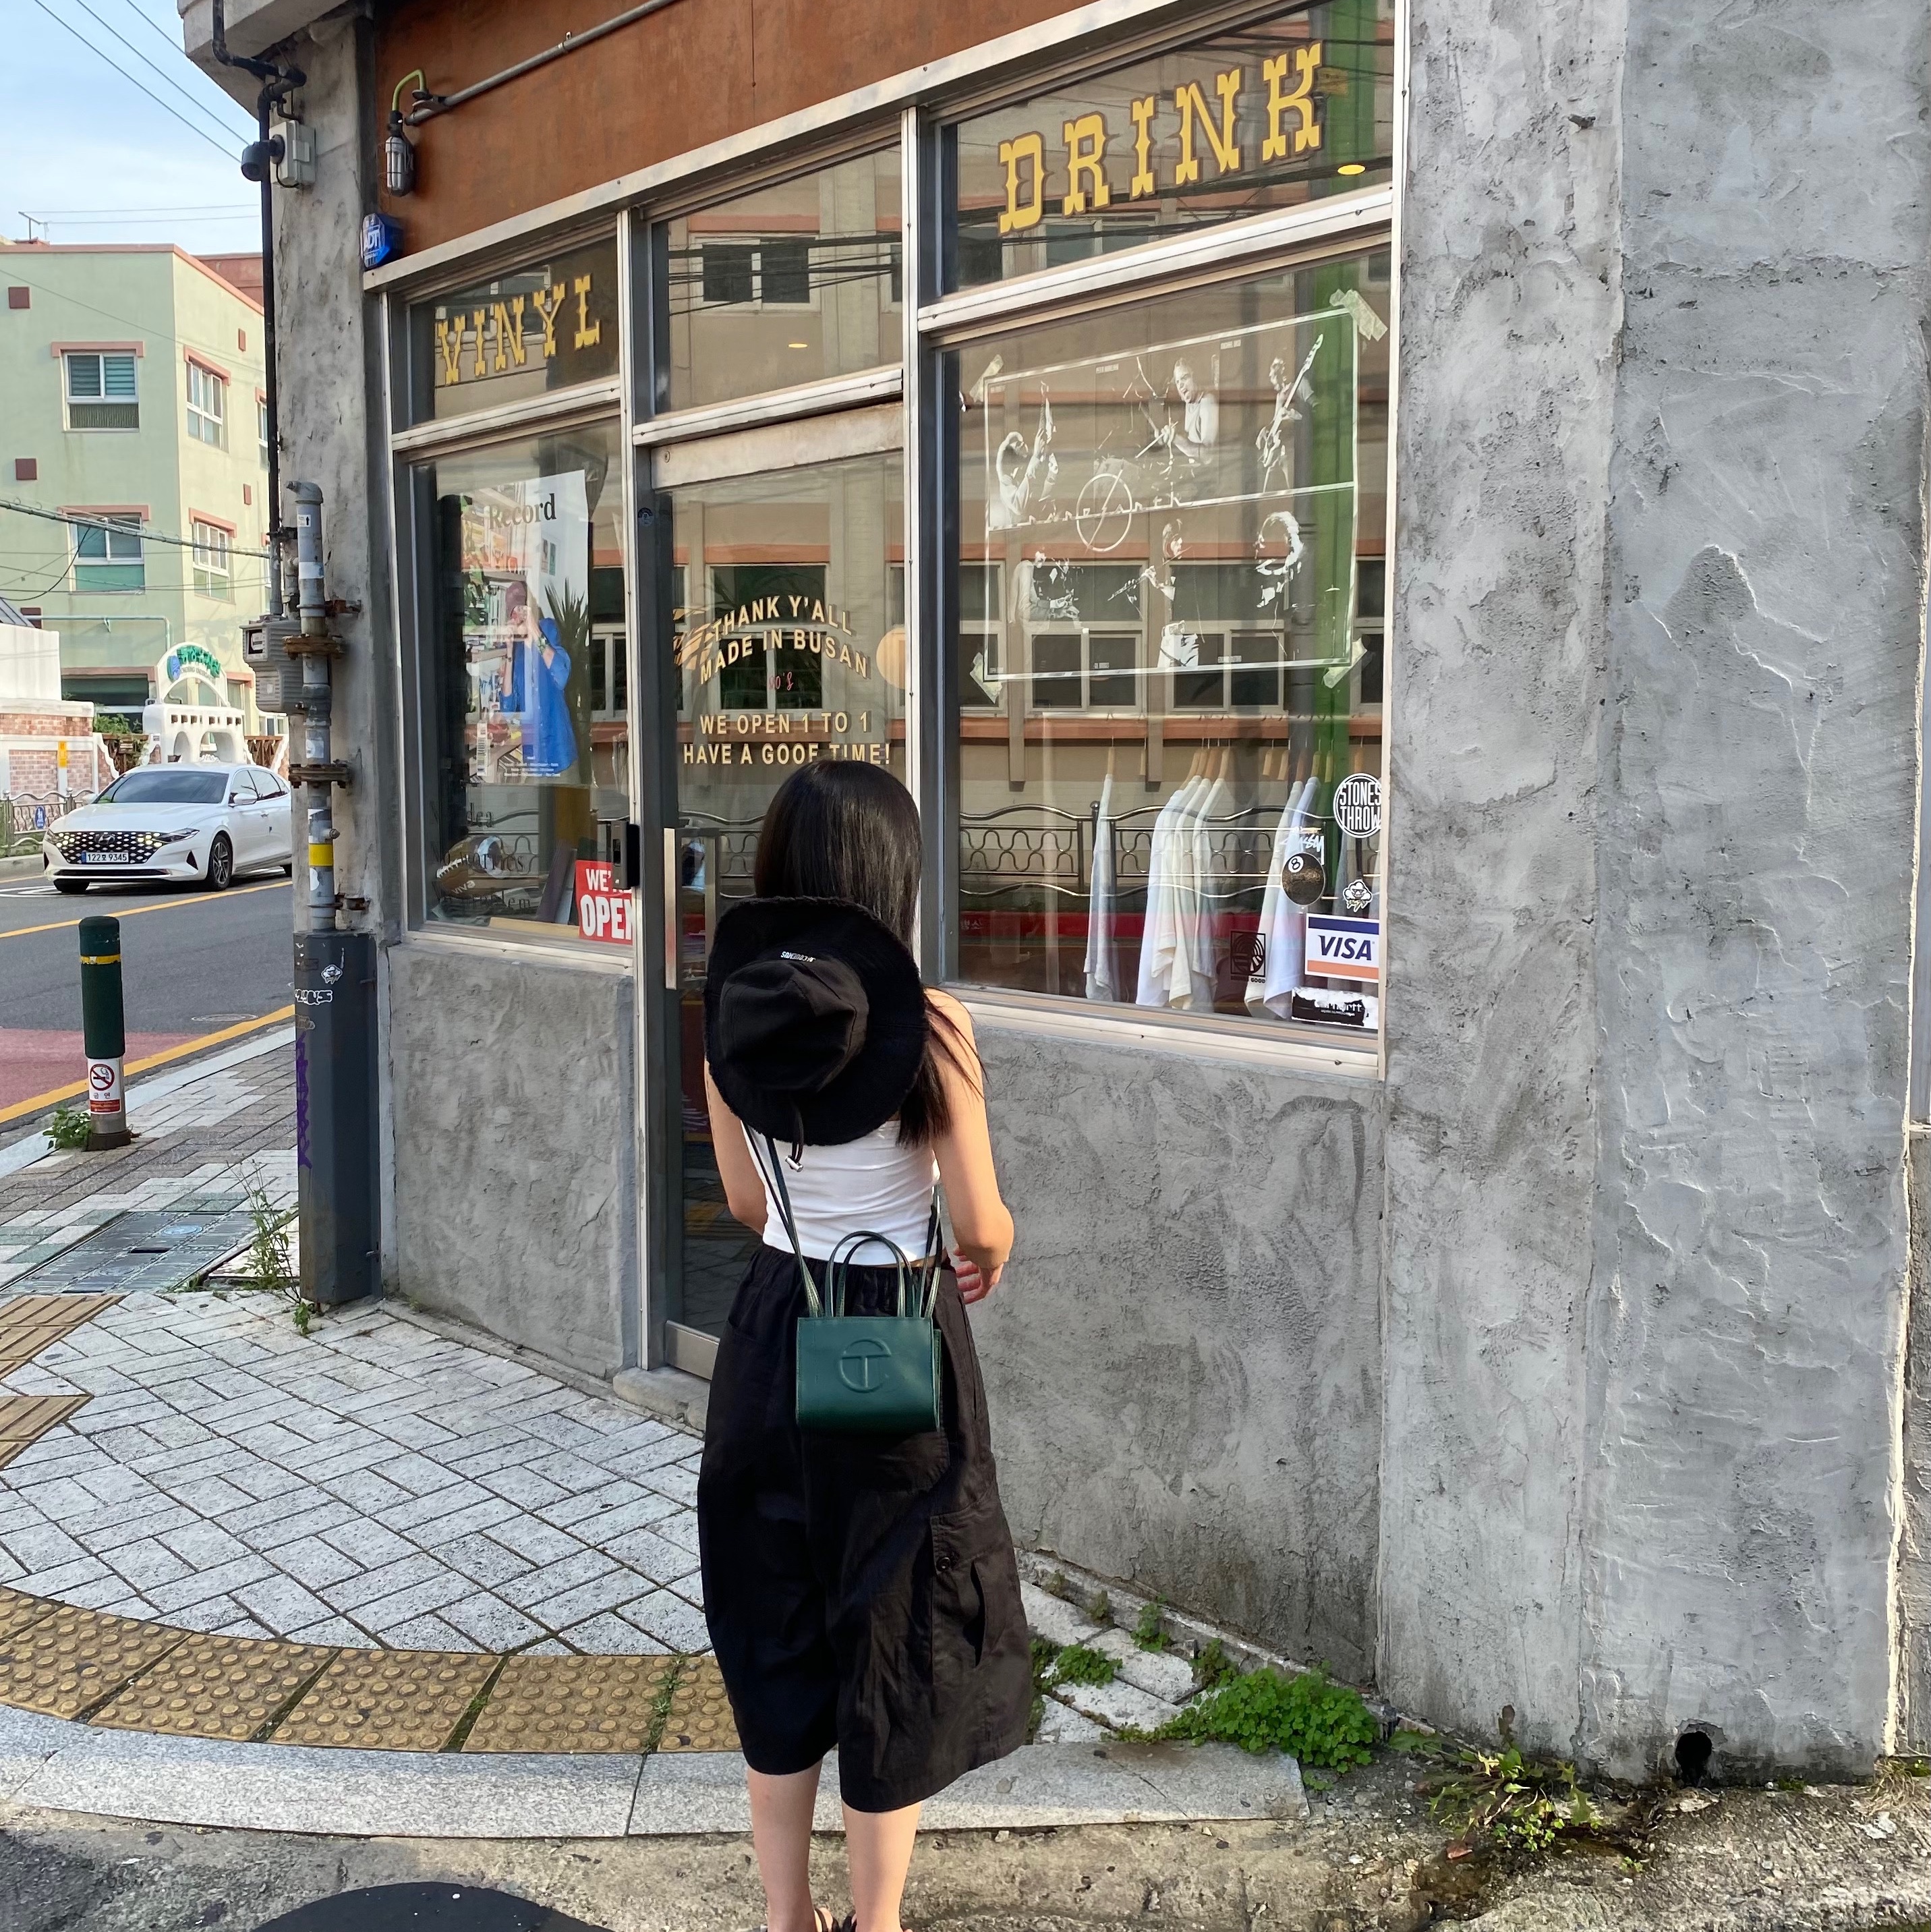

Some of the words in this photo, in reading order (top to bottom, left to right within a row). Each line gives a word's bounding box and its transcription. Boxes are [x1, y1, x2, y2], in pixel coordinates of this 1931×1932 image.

[999, 40, 1323, 234] DRINK
[364, 229, 381, 250] ADT
[436, 274, 600, 385] VINYL
[490, 493, 556, 530] Record
[712, 595, 780, 642] THANK
[788, 595, 852, 635] Y'ALL
[701, 635, 753, 685] MADE
[763, 629, 782, 652] IN
[794, 629, 868, 679] BUSAN
[700, 714, 726, 735] WE
[737, 714, 790, 734] OPEN
[801, 714, 809, 733] 1
[821, 712, 848, 733] TO
[860, 711, 869, 733] 1
[683, 743, 732, 765] HAVE
[740, 743, 753, 764] A
[829, 743, 890, 764] TIME!
[1339, 782, 1381, 805] STONES
[1339, 806, 1381, 830] THROW
[1291, 858, 1301, 870] 8
[585, 868, 633, 894] WE'
[1318, 935, 1372, 961] VISA
